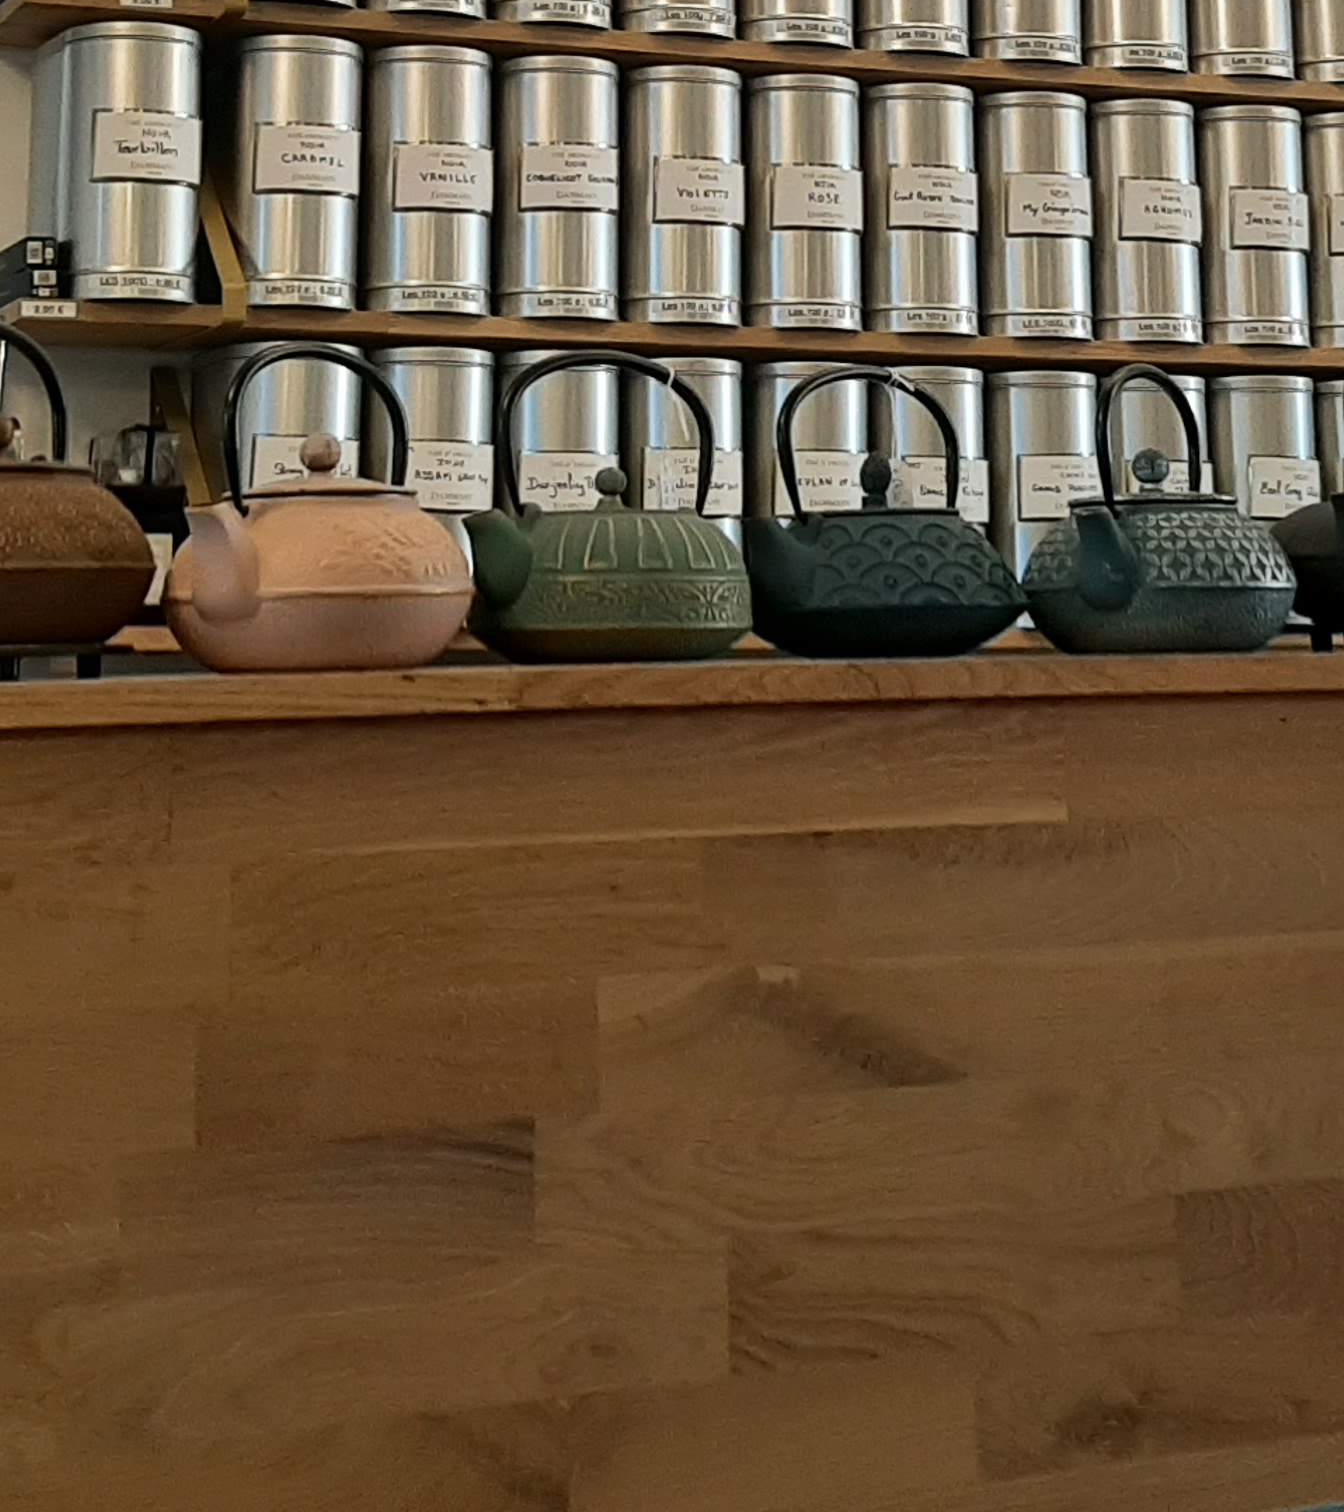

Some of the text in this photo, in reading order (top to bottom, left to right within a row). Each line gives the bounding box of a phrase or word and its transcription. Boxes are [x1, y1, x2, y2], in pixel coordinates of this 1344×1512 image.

[281, 152, 345, 168] CARAMEL
[419, 171, 477, 185] VANILLE
[807, 191, 841, 205] ROSE
[525, 474, 587, 496] Darjeeling
